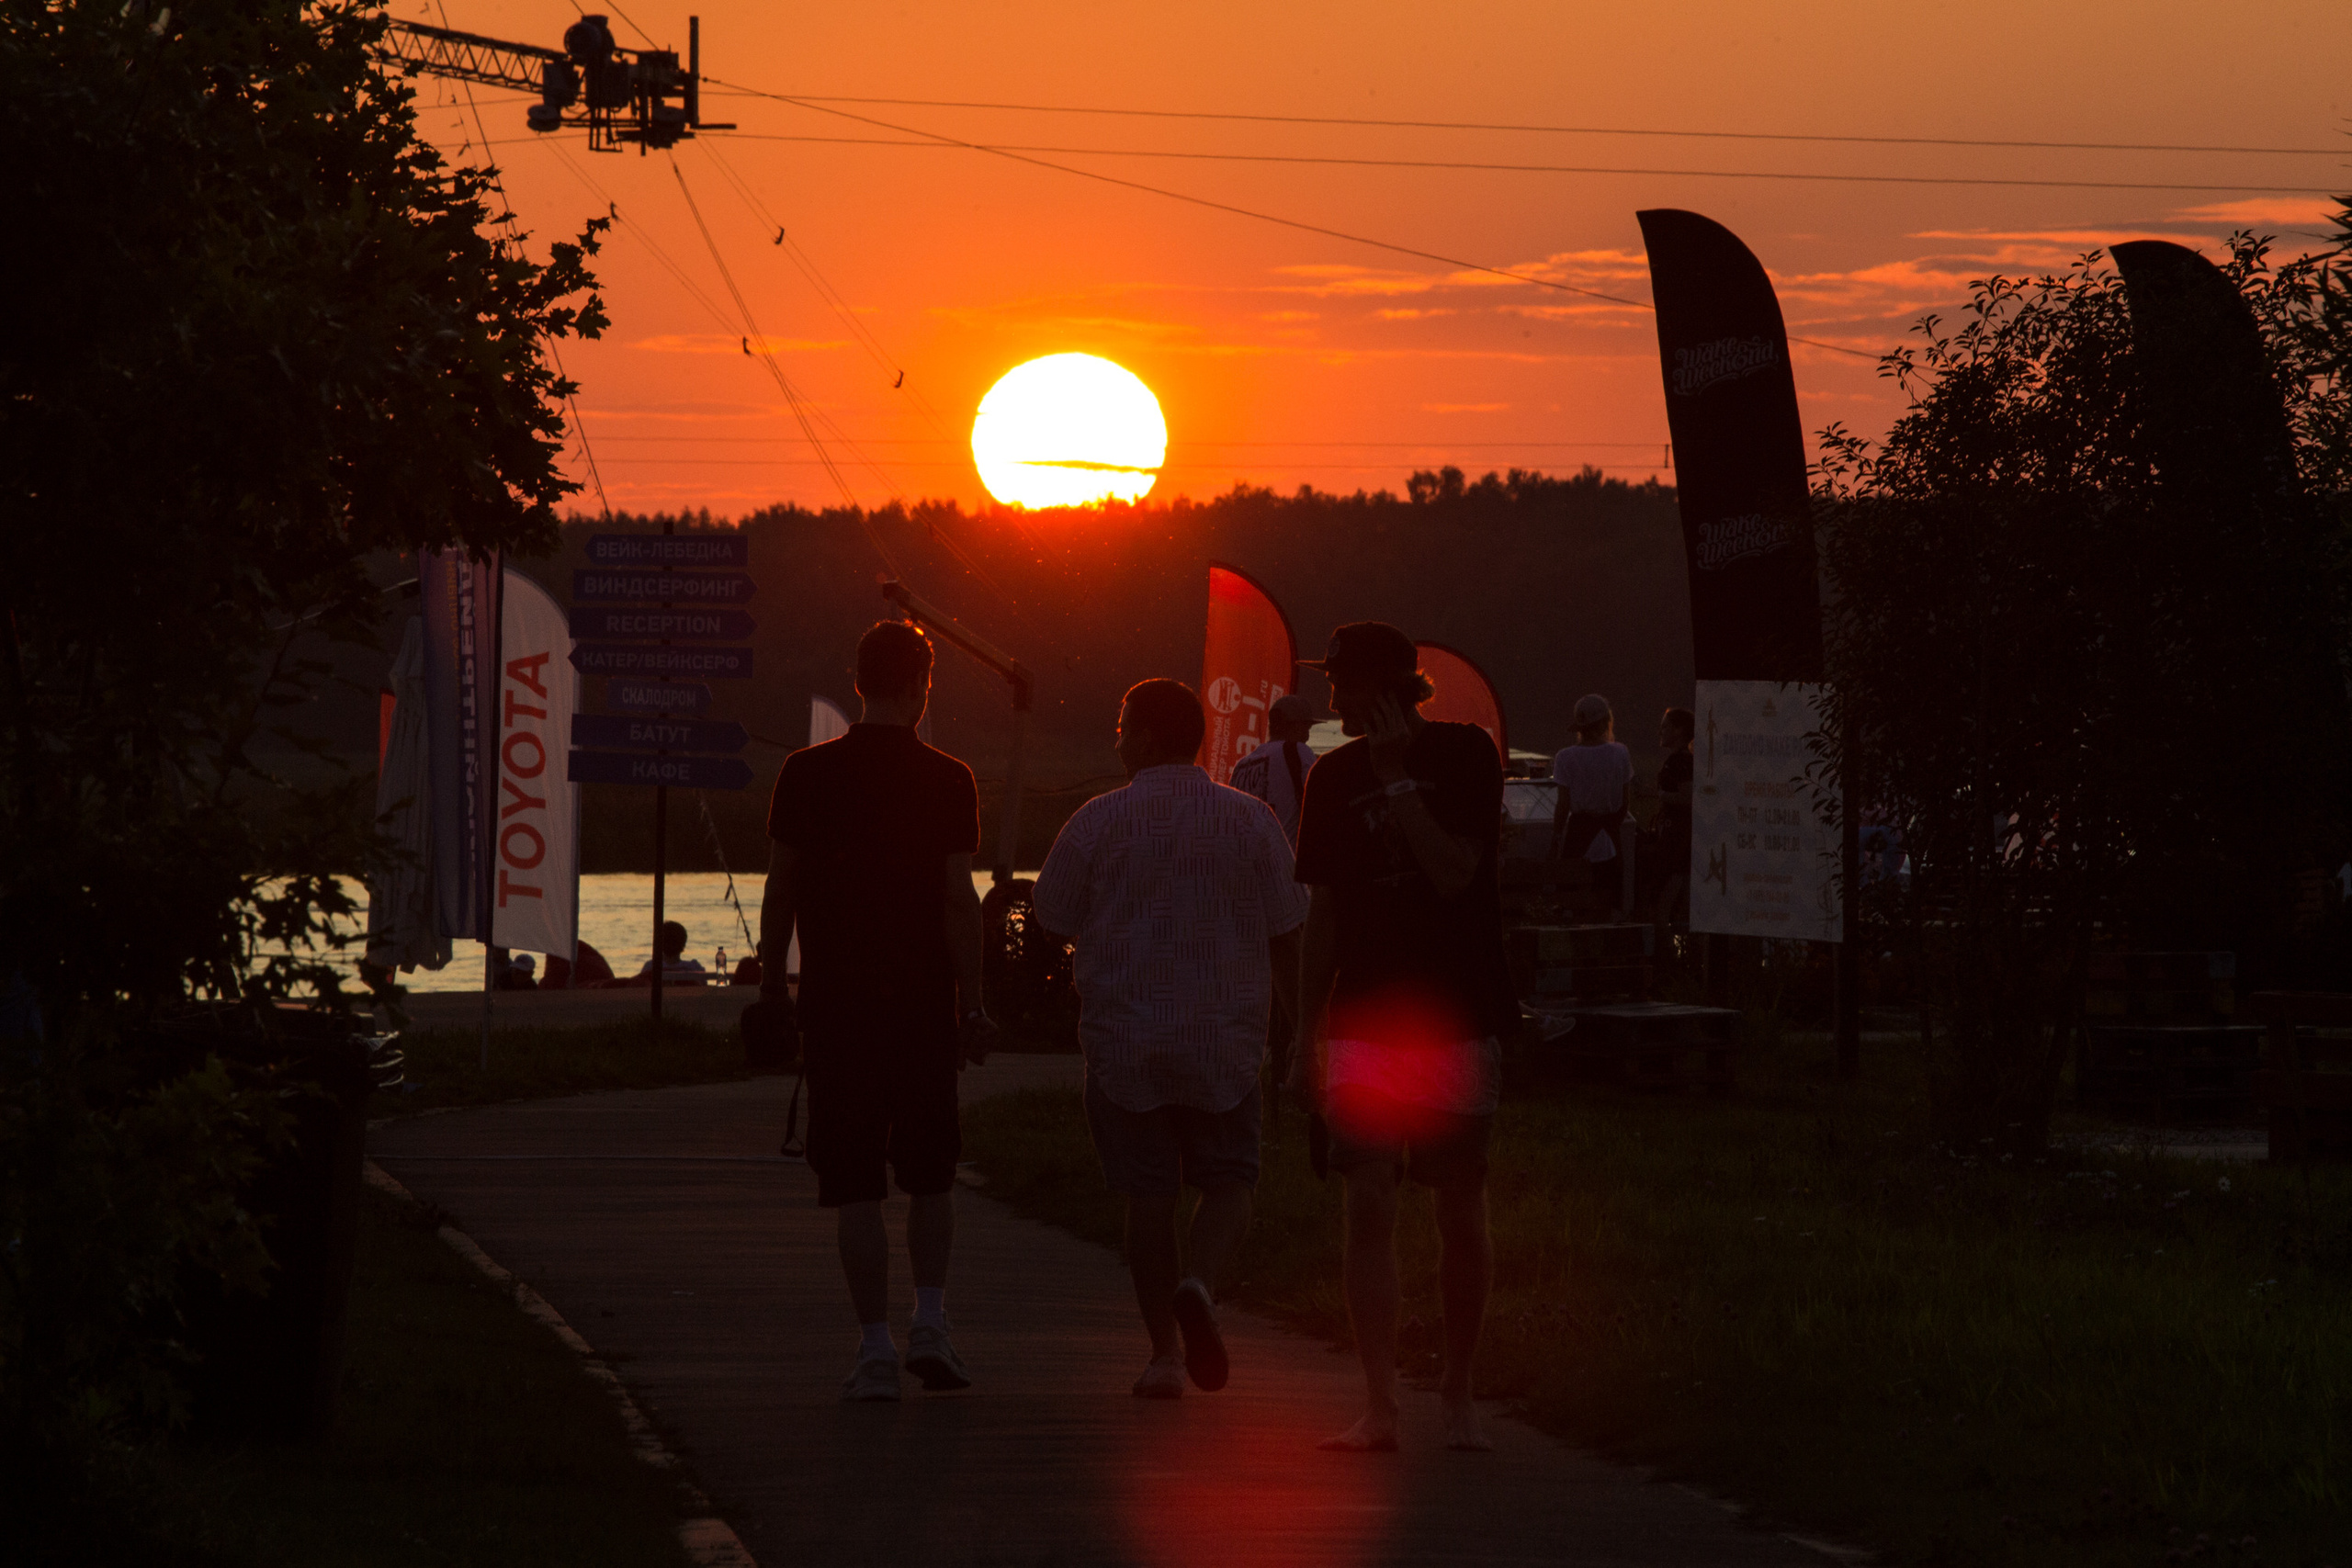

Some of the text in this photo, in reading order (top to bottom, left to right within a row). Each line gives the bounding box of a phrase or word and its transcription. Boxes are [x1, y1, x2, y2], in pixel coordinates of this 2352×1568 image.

[596, 541, 732, 561] ВЕЙК-ЛЕБЕДКА
[584, 577, 743, 597] ВИНДСЕРФИНГ
[606, 615, 721, 633] RECEPTION
[582, 650, 740, 670] КАТЕР/ВЕЙКСЕРФ
[622, 687, 696, 707] СКАЛОДРОМ
[629, 723, 691, 743] БАТУТ
[1221, 716, 1231, 756] ТОЙОТА
[499, 652, 549, 908] TOYOTA
[632, 761, 690, 781] КАФЕ
